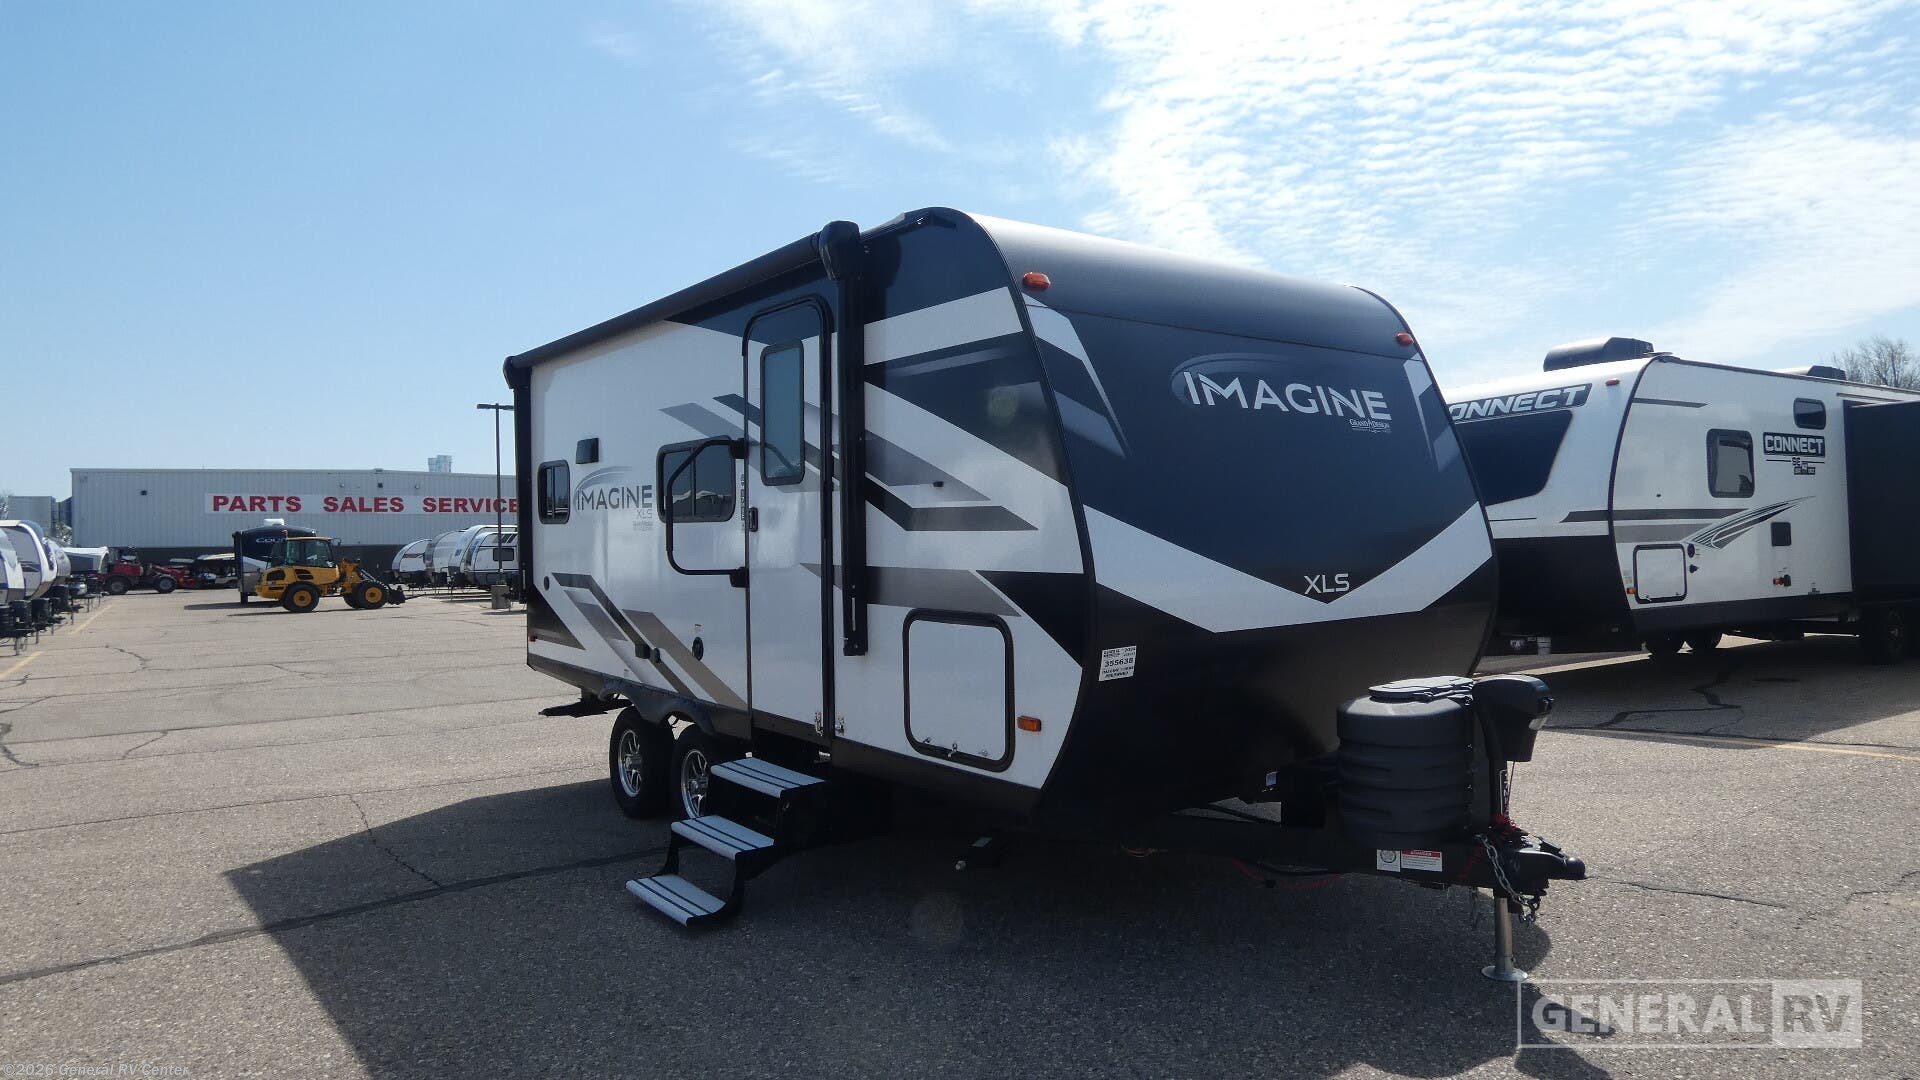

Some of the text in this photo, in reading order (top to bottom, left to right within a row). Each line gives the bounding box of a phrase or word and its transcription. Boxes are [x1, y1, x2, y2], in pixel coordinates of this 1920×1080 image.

[1184, 371, 1392, 420] IMAGINE
[1449, 386, 1586, 420] ONNECT
[1764, 435, 1824, 454] CONNECT
[213, 495, 302, 512] PARTS
[323, 496, 405, 513] SALES
[577, 485, 653, 511] IMAGINE
[1303, 573, 1350, 595] XLS
